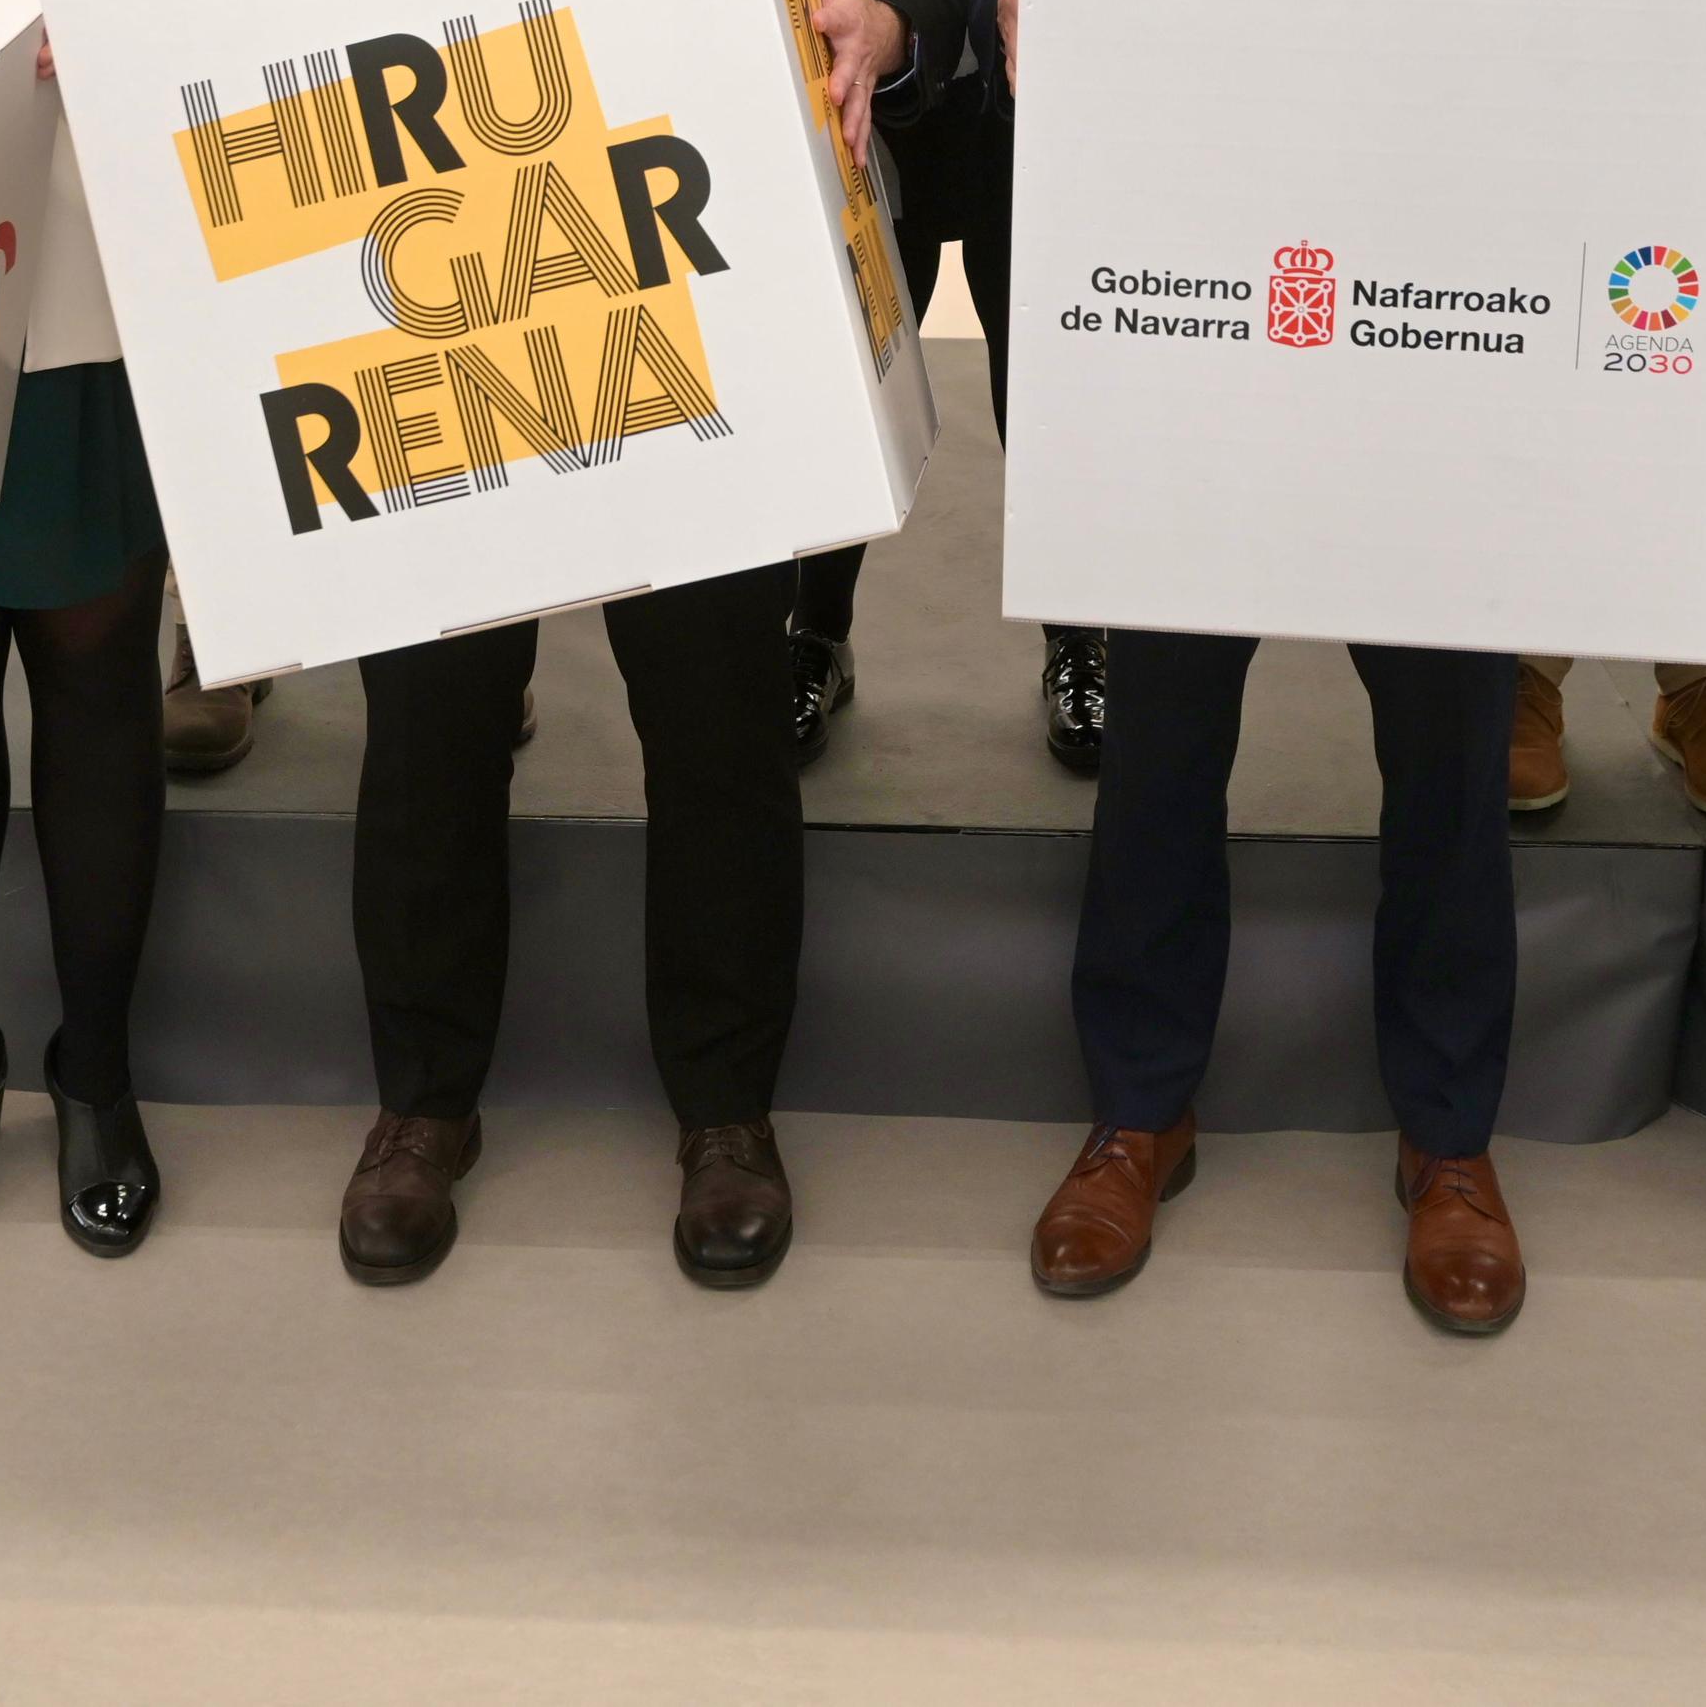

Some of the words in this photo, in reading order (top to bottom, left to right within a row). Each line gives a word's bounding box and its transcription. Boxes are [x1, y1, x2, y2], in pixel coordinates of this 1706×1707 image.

[361, 134, 731, 340] GAR
[1091, 267, 1253, 303] Gobierno
[1352, 279, 1552, 316] Nafarroako
[1060, 304, 1103, 333] de
[1113, 307, 1251, 341] Navarra
[1350, 320, 1525, 356] Gobernua
[1604, 333, 1694, 354] AGENDA
[1603, 352, 1693, 376] 2030
[259, 304, 733, 536] RENA
